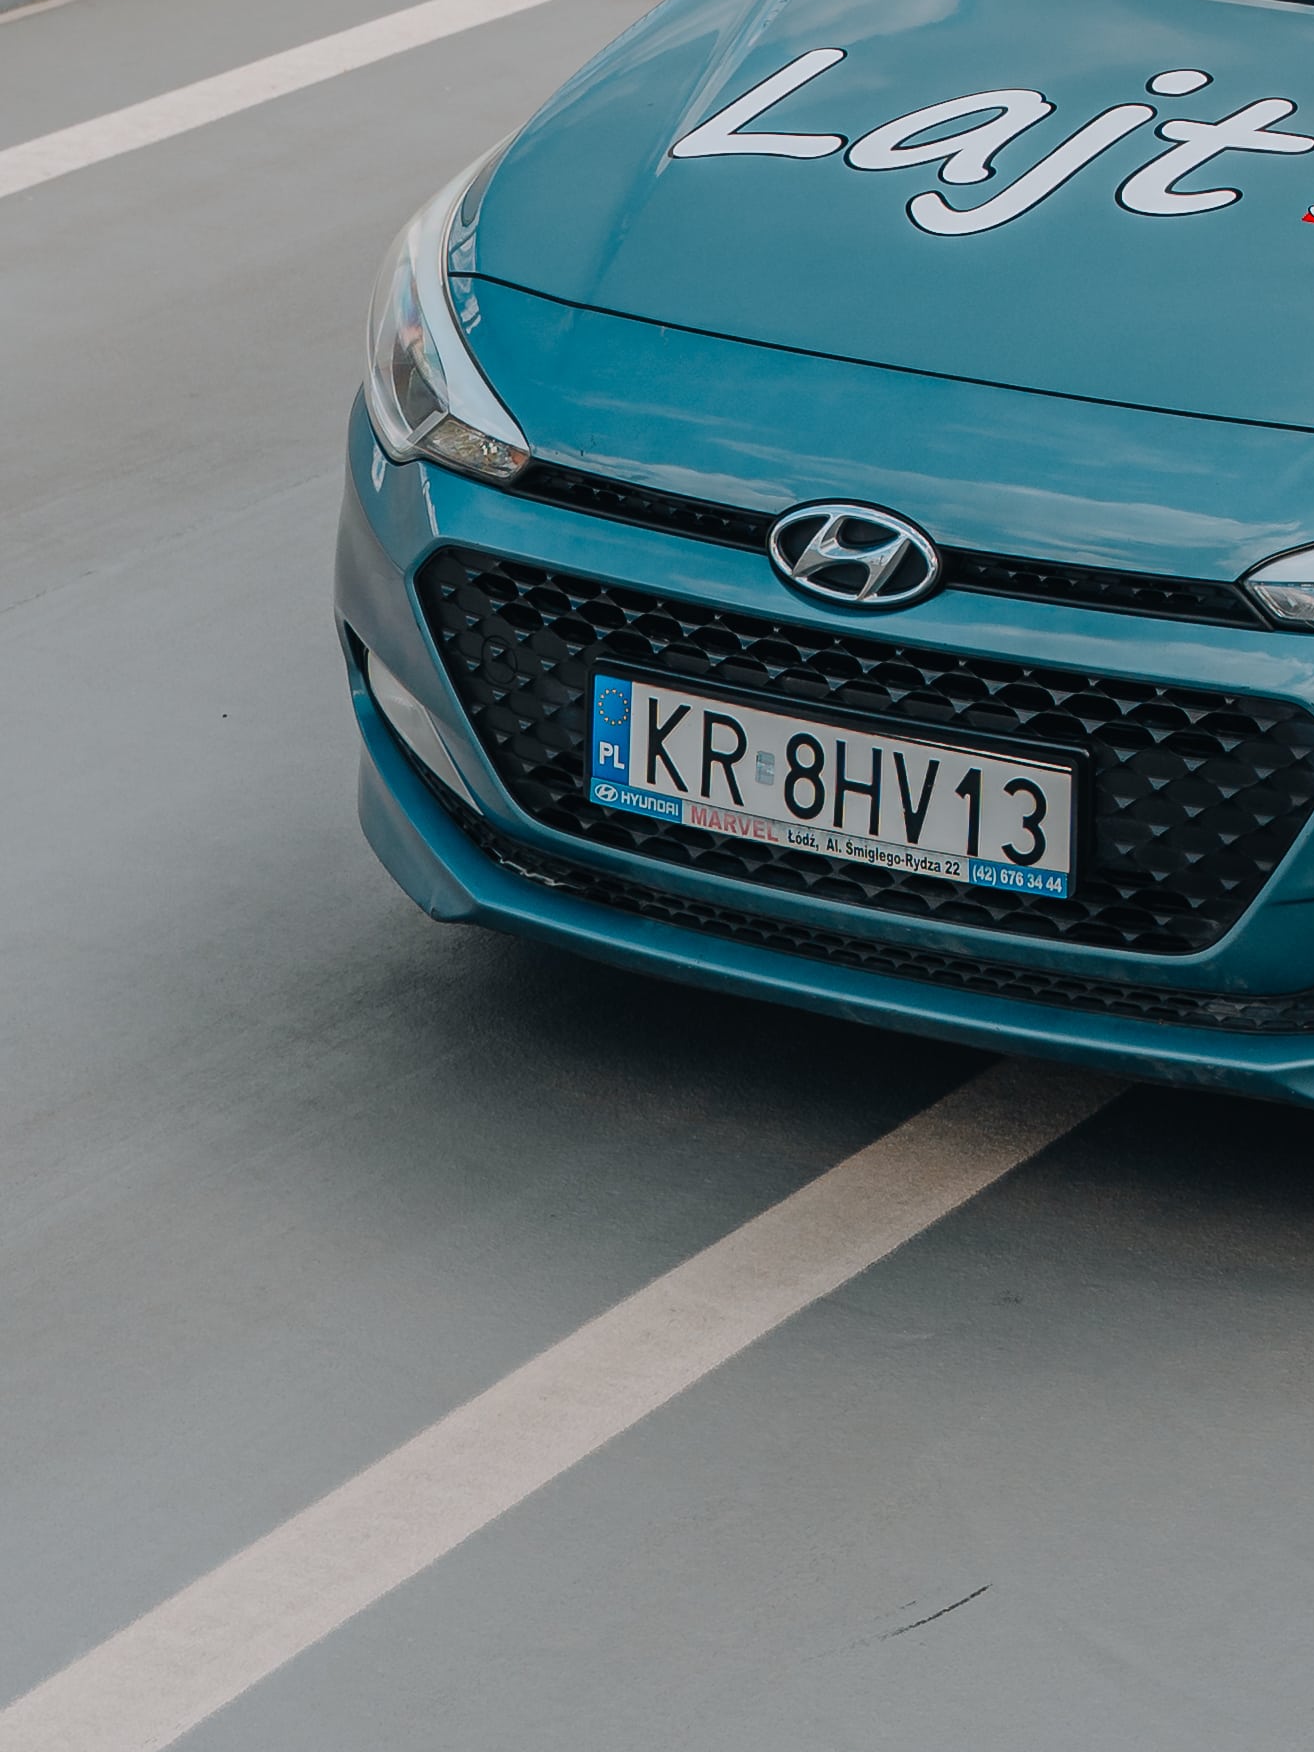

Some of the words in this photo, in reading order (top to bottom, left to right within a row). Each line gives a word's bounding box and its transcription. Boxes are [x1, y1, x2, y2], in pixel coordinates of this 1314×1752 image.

[598, 740, 626, 770] PL
[646, 696, 748, 807] KR
[783, 732, 1048, 867] 8HV13
[620, 790, 679, 817] HYUNDAI
[690, 804, 780, 843] MARVEL
[826, 837, 842, 854] Al.
[944, 860, 961, 876] 22
[972, 865, 997, 886] (42)
[1000, 869, 1024, 887] 676
[1027, 873, 1043, 890] 34
[1046, 876, 1063, 893] 44
